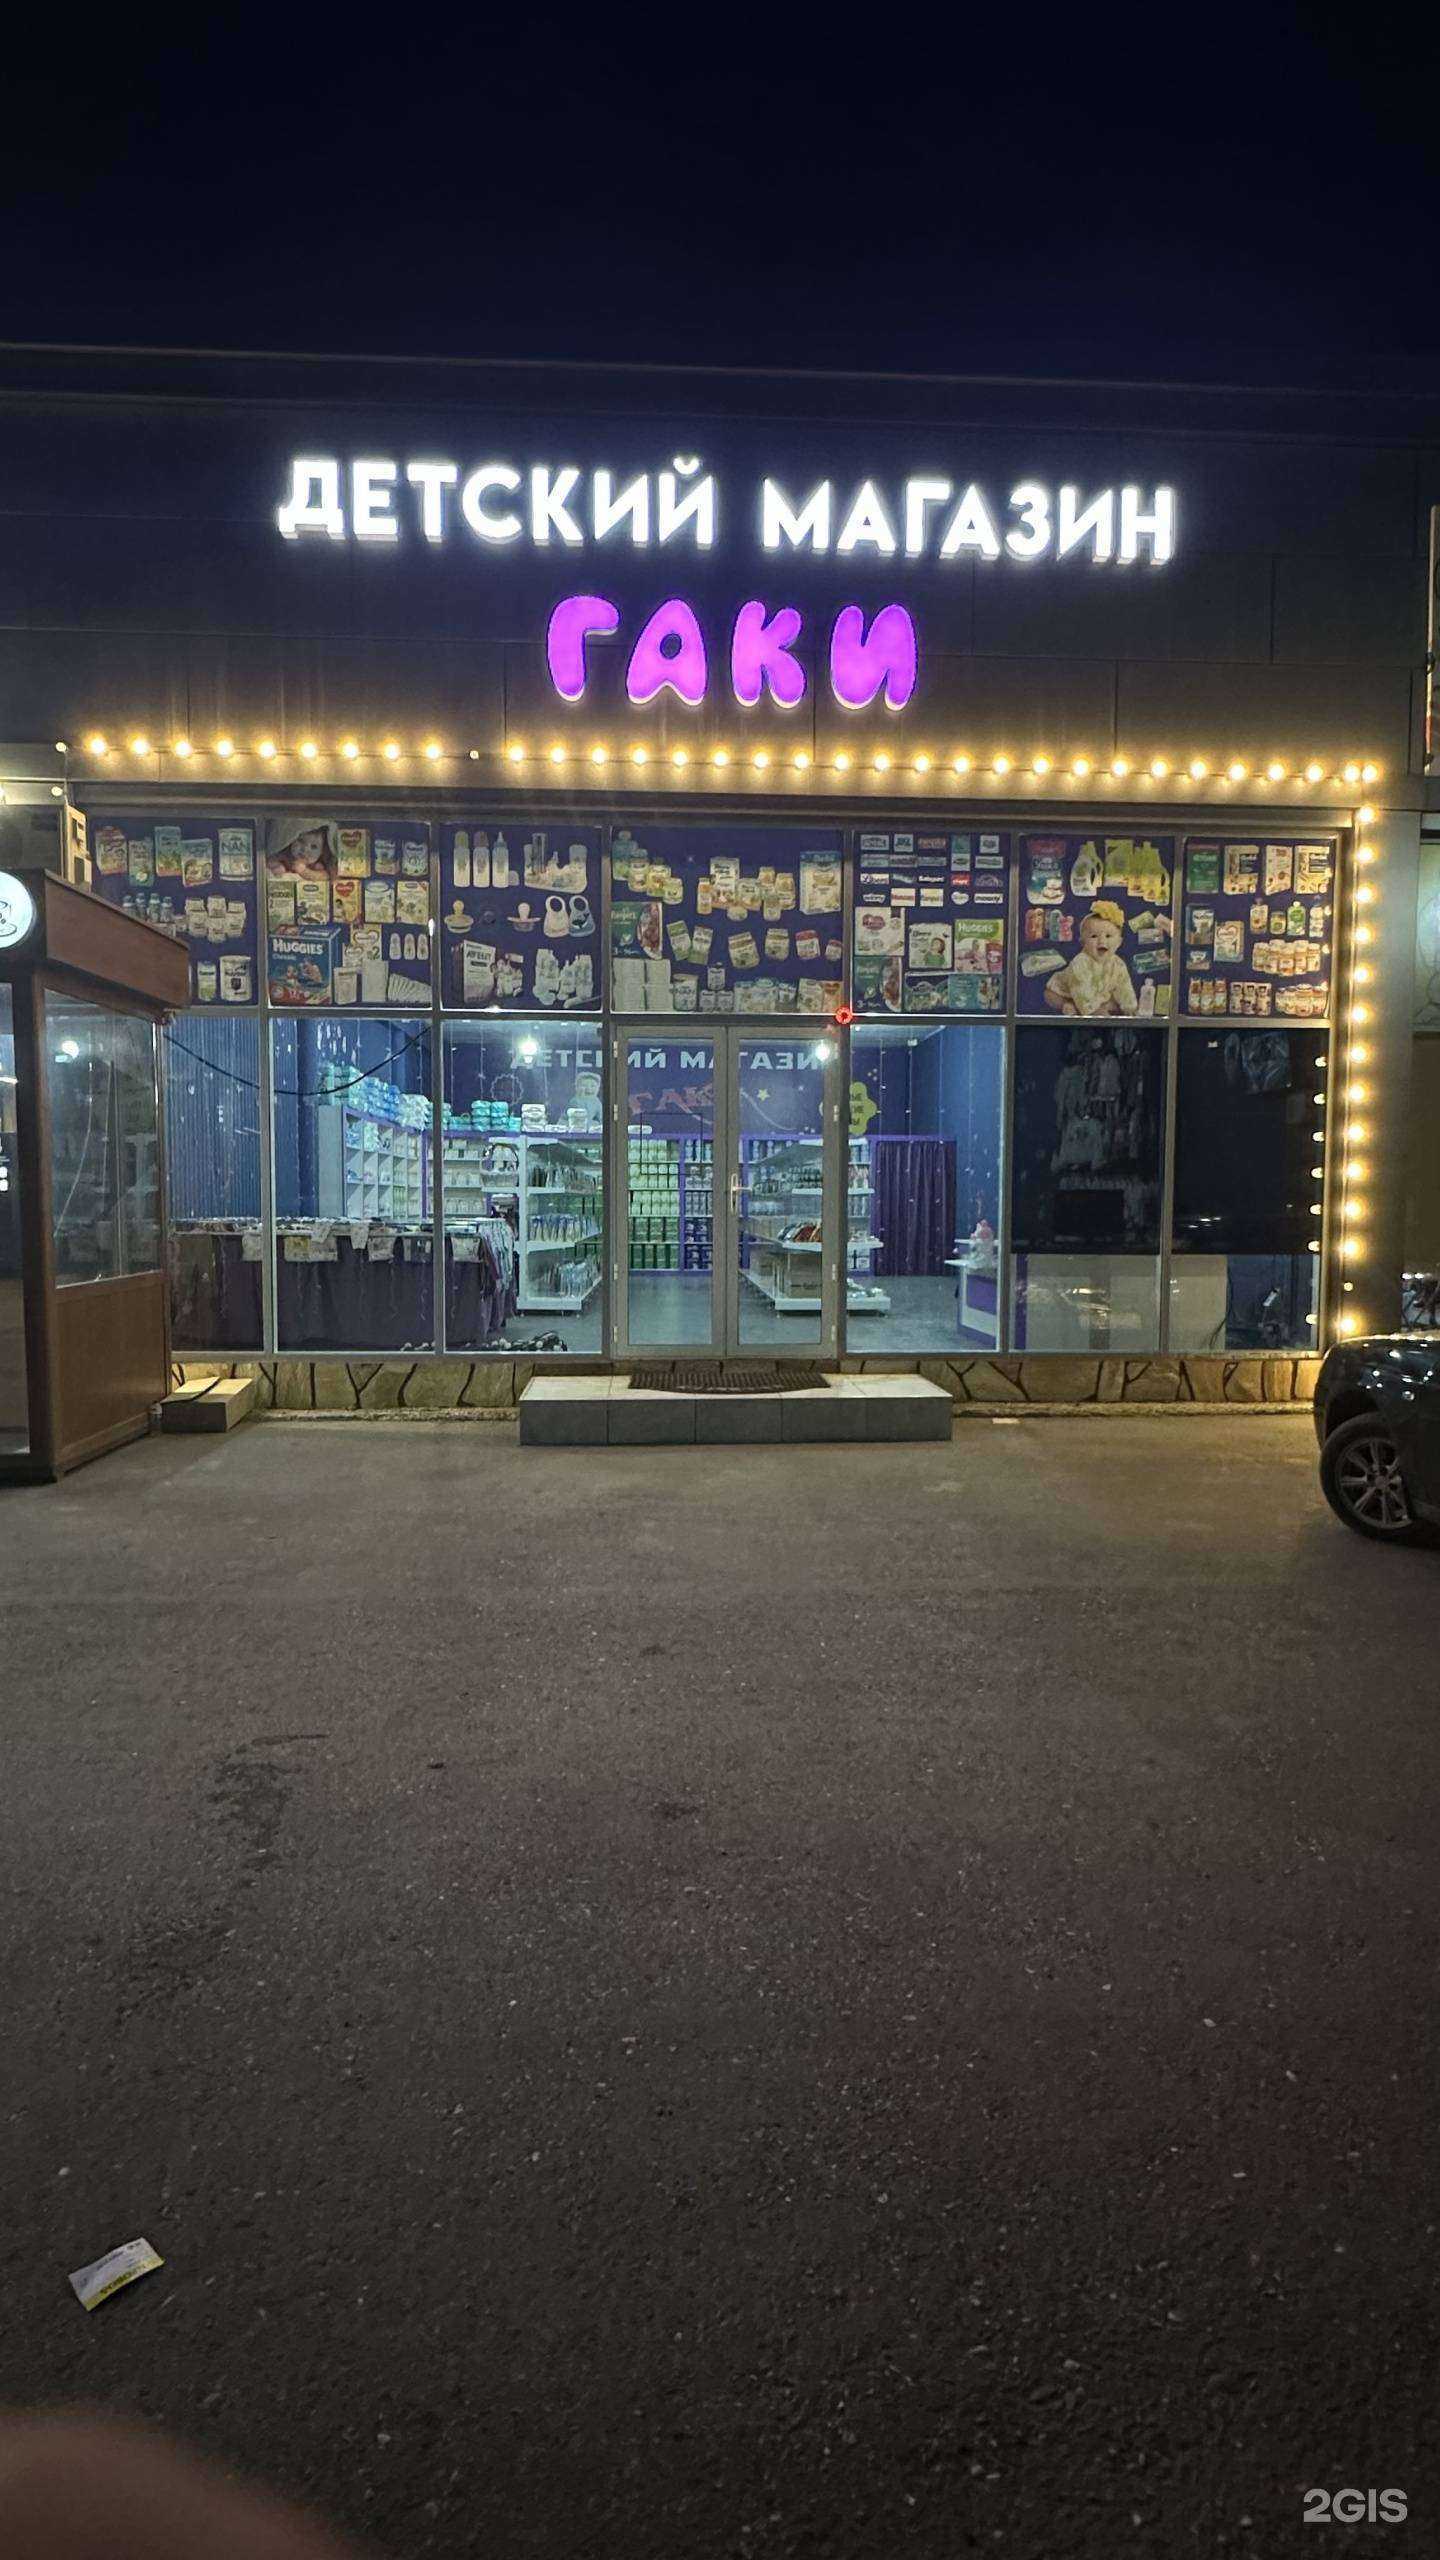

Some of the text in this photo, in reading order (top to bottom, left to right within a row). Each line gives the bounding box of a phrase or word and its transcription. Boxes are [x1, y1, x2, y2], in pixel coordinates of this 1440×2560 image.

[278, 456, 1176, 566] ДЕТСКИЙ МАГАЗИН
[545, 594, 918, 712] ГАКИ
[272, 938, 325, 955] HUGGIES
